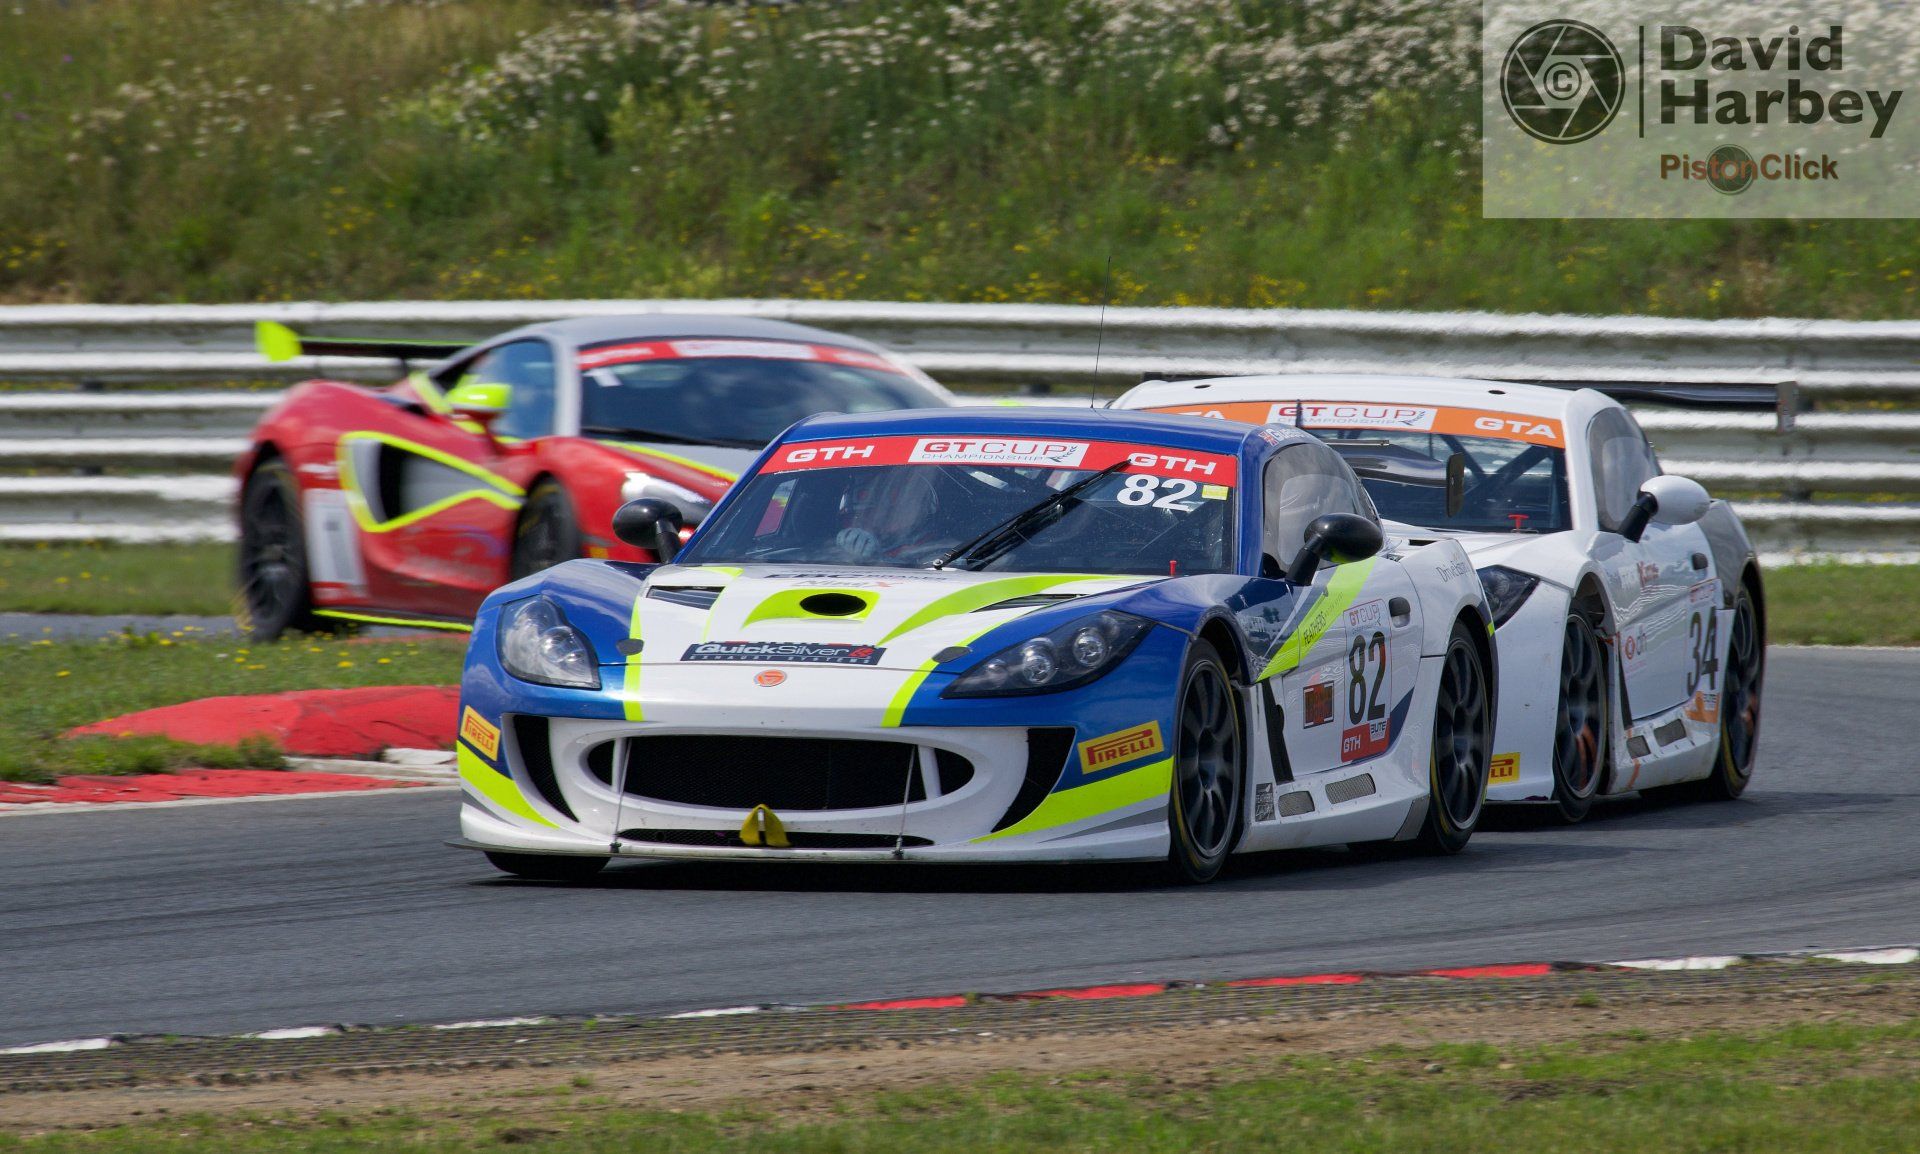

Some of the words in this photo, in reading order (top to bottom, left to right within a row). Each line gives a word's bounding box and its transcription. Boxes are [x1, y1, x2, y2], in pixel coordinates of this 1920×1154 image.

[1278, 406, 1328, 417] GT
[1333, 407, 1417, 419] CUP
[1474, 416, 1557, 440] GTA
[786, 445, 875, 464] GTH
[921, 453, 1044, 462] CHAMPIONSHIP
[923, 442, 976, 453] GT
[981, 442, 1068, 456] CUP
[1128, 451, 1217, 476] GTH
[1115, 474, 1198, 512] 82
[694, 643, 850, 657] QuickSilver
[1687, 605, 1719, 697] 34
[1349, 631, 1386, 725] 82
[465, 714, 495, 752] PIRELLI
[1343, 734, 1361, 753] GTH
[1086, 728, 1155, 766] PIRELLI
